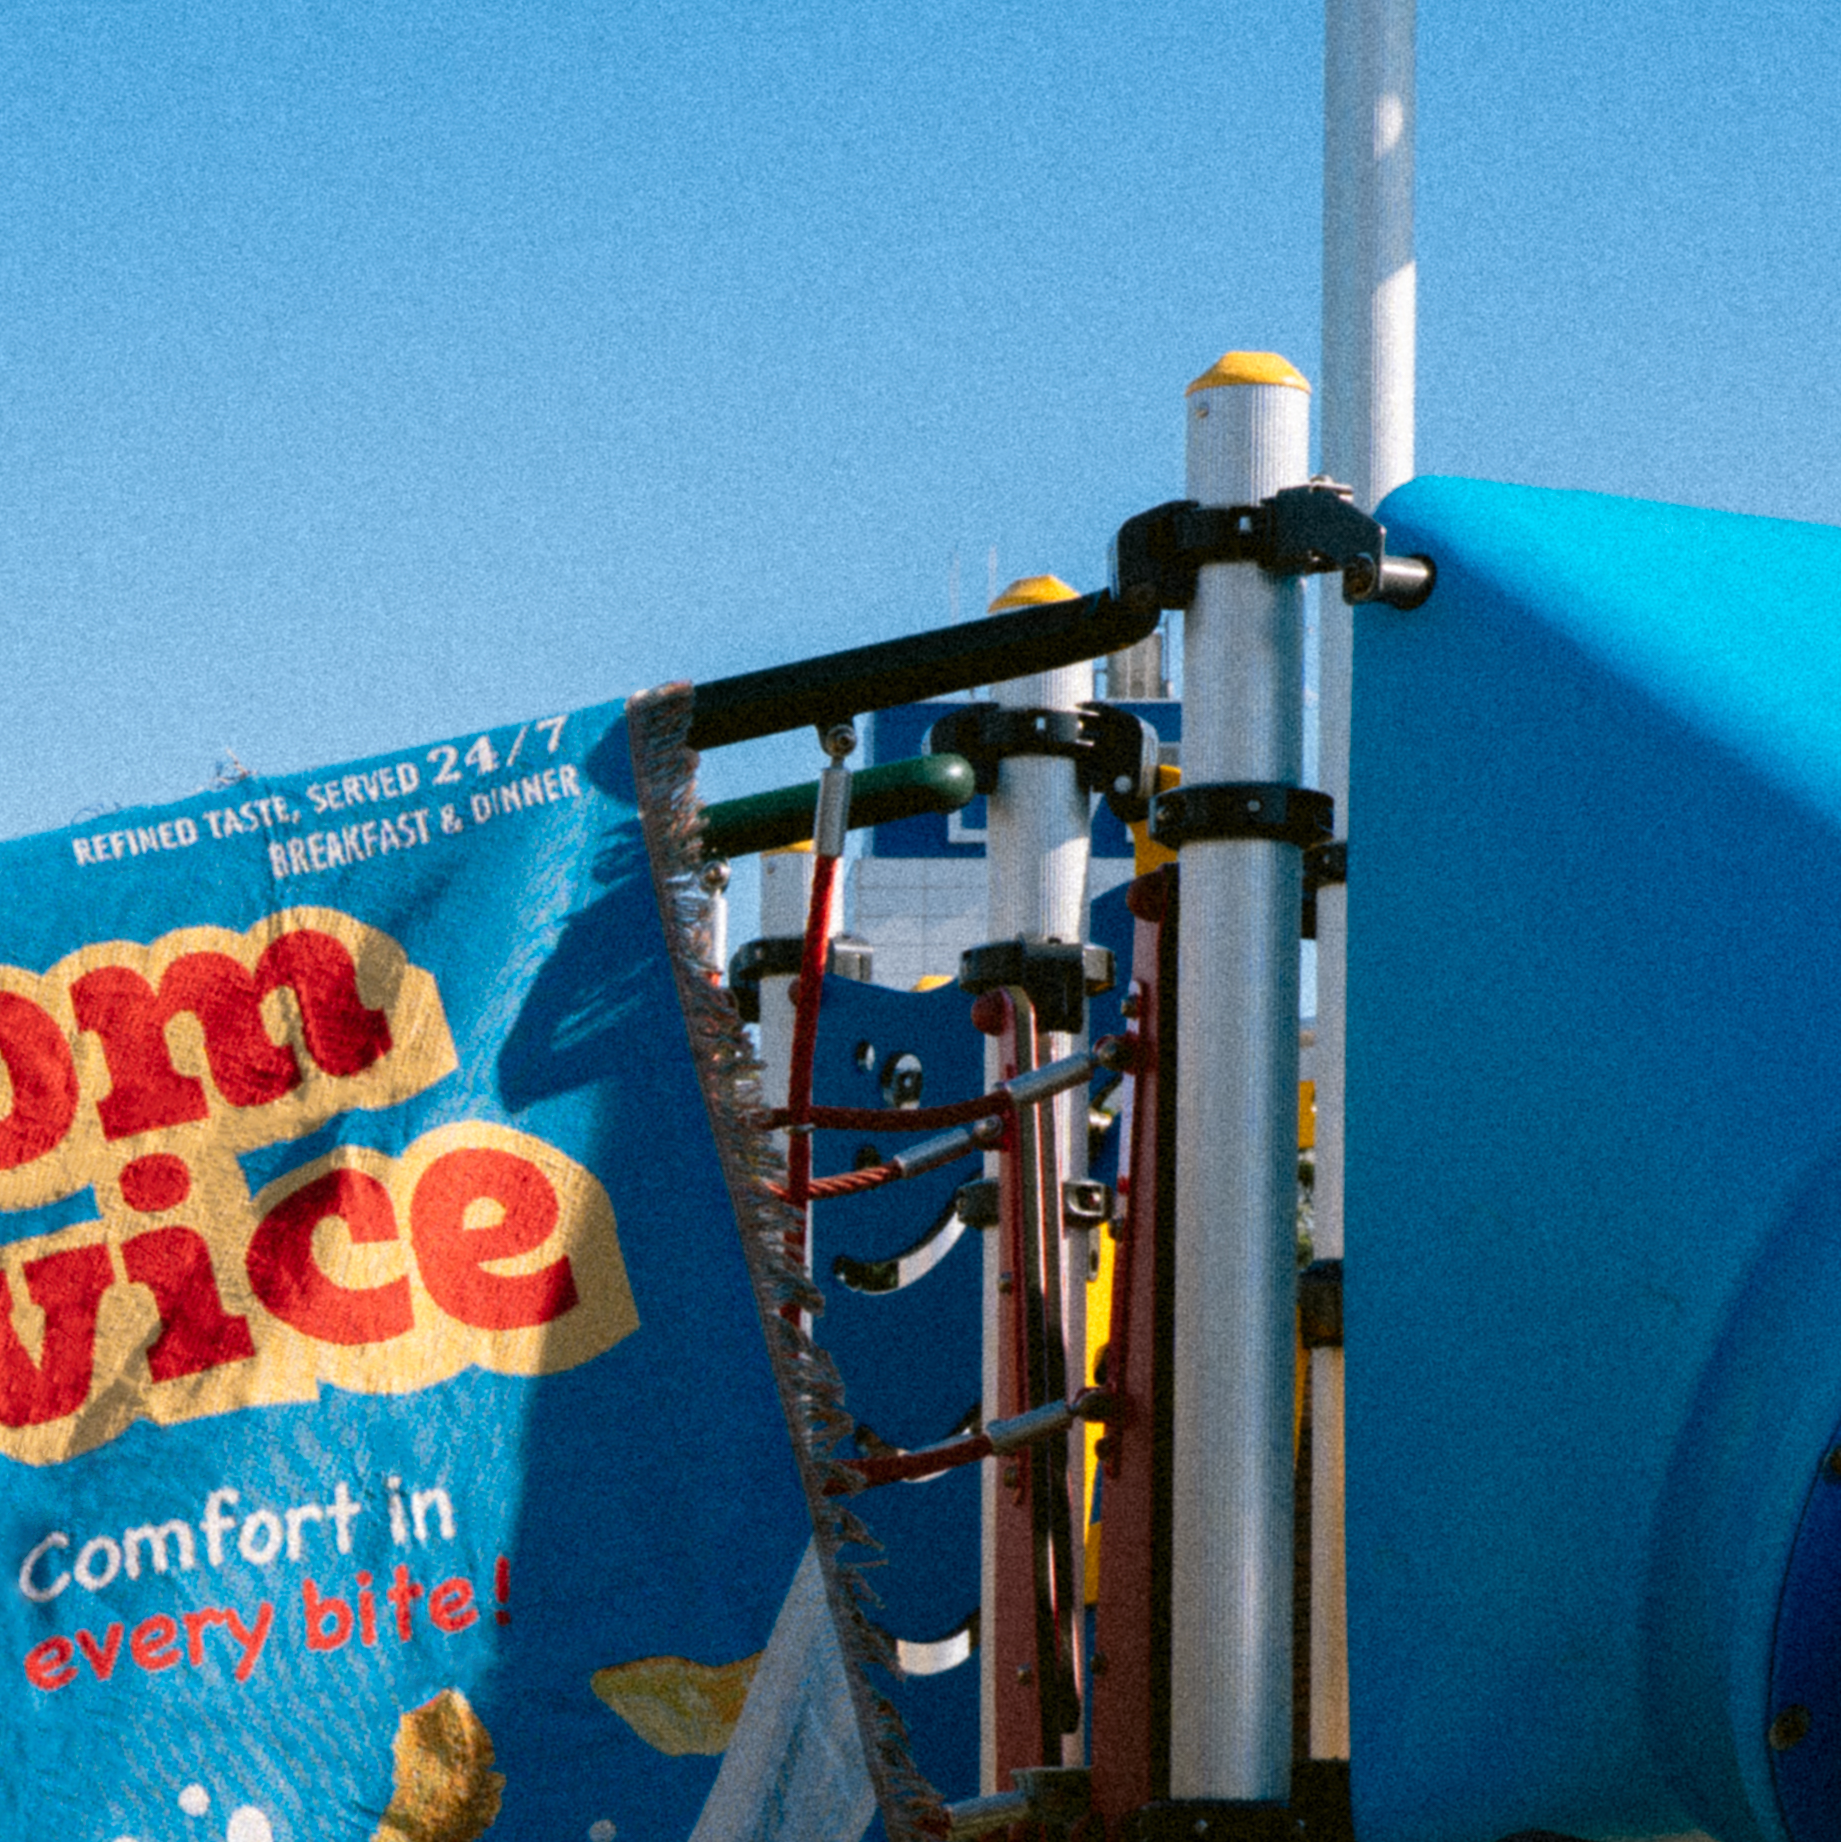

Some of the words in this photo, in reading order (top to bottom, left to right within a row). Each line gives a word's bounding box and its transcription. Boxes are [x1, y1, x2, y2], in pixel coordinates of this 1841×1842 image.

[72, 816, 199, 867] REFINED
[202, 795, 301, 840] TASTE,
[306, 761, 420, 815] SERVED
[426, 714, 570, 786] 24/7
[268, 807, 430, 880] BREAKFAST
[440, 802, 465, 836] &
[470, 762, 582, 825] DINNER
[18, 1480, 361, 1602] Comfort
[387, 1475, 456, 1546] in
[22, 1600, 274, 1691] every
[301, 1554, 512, 1652] bite!
